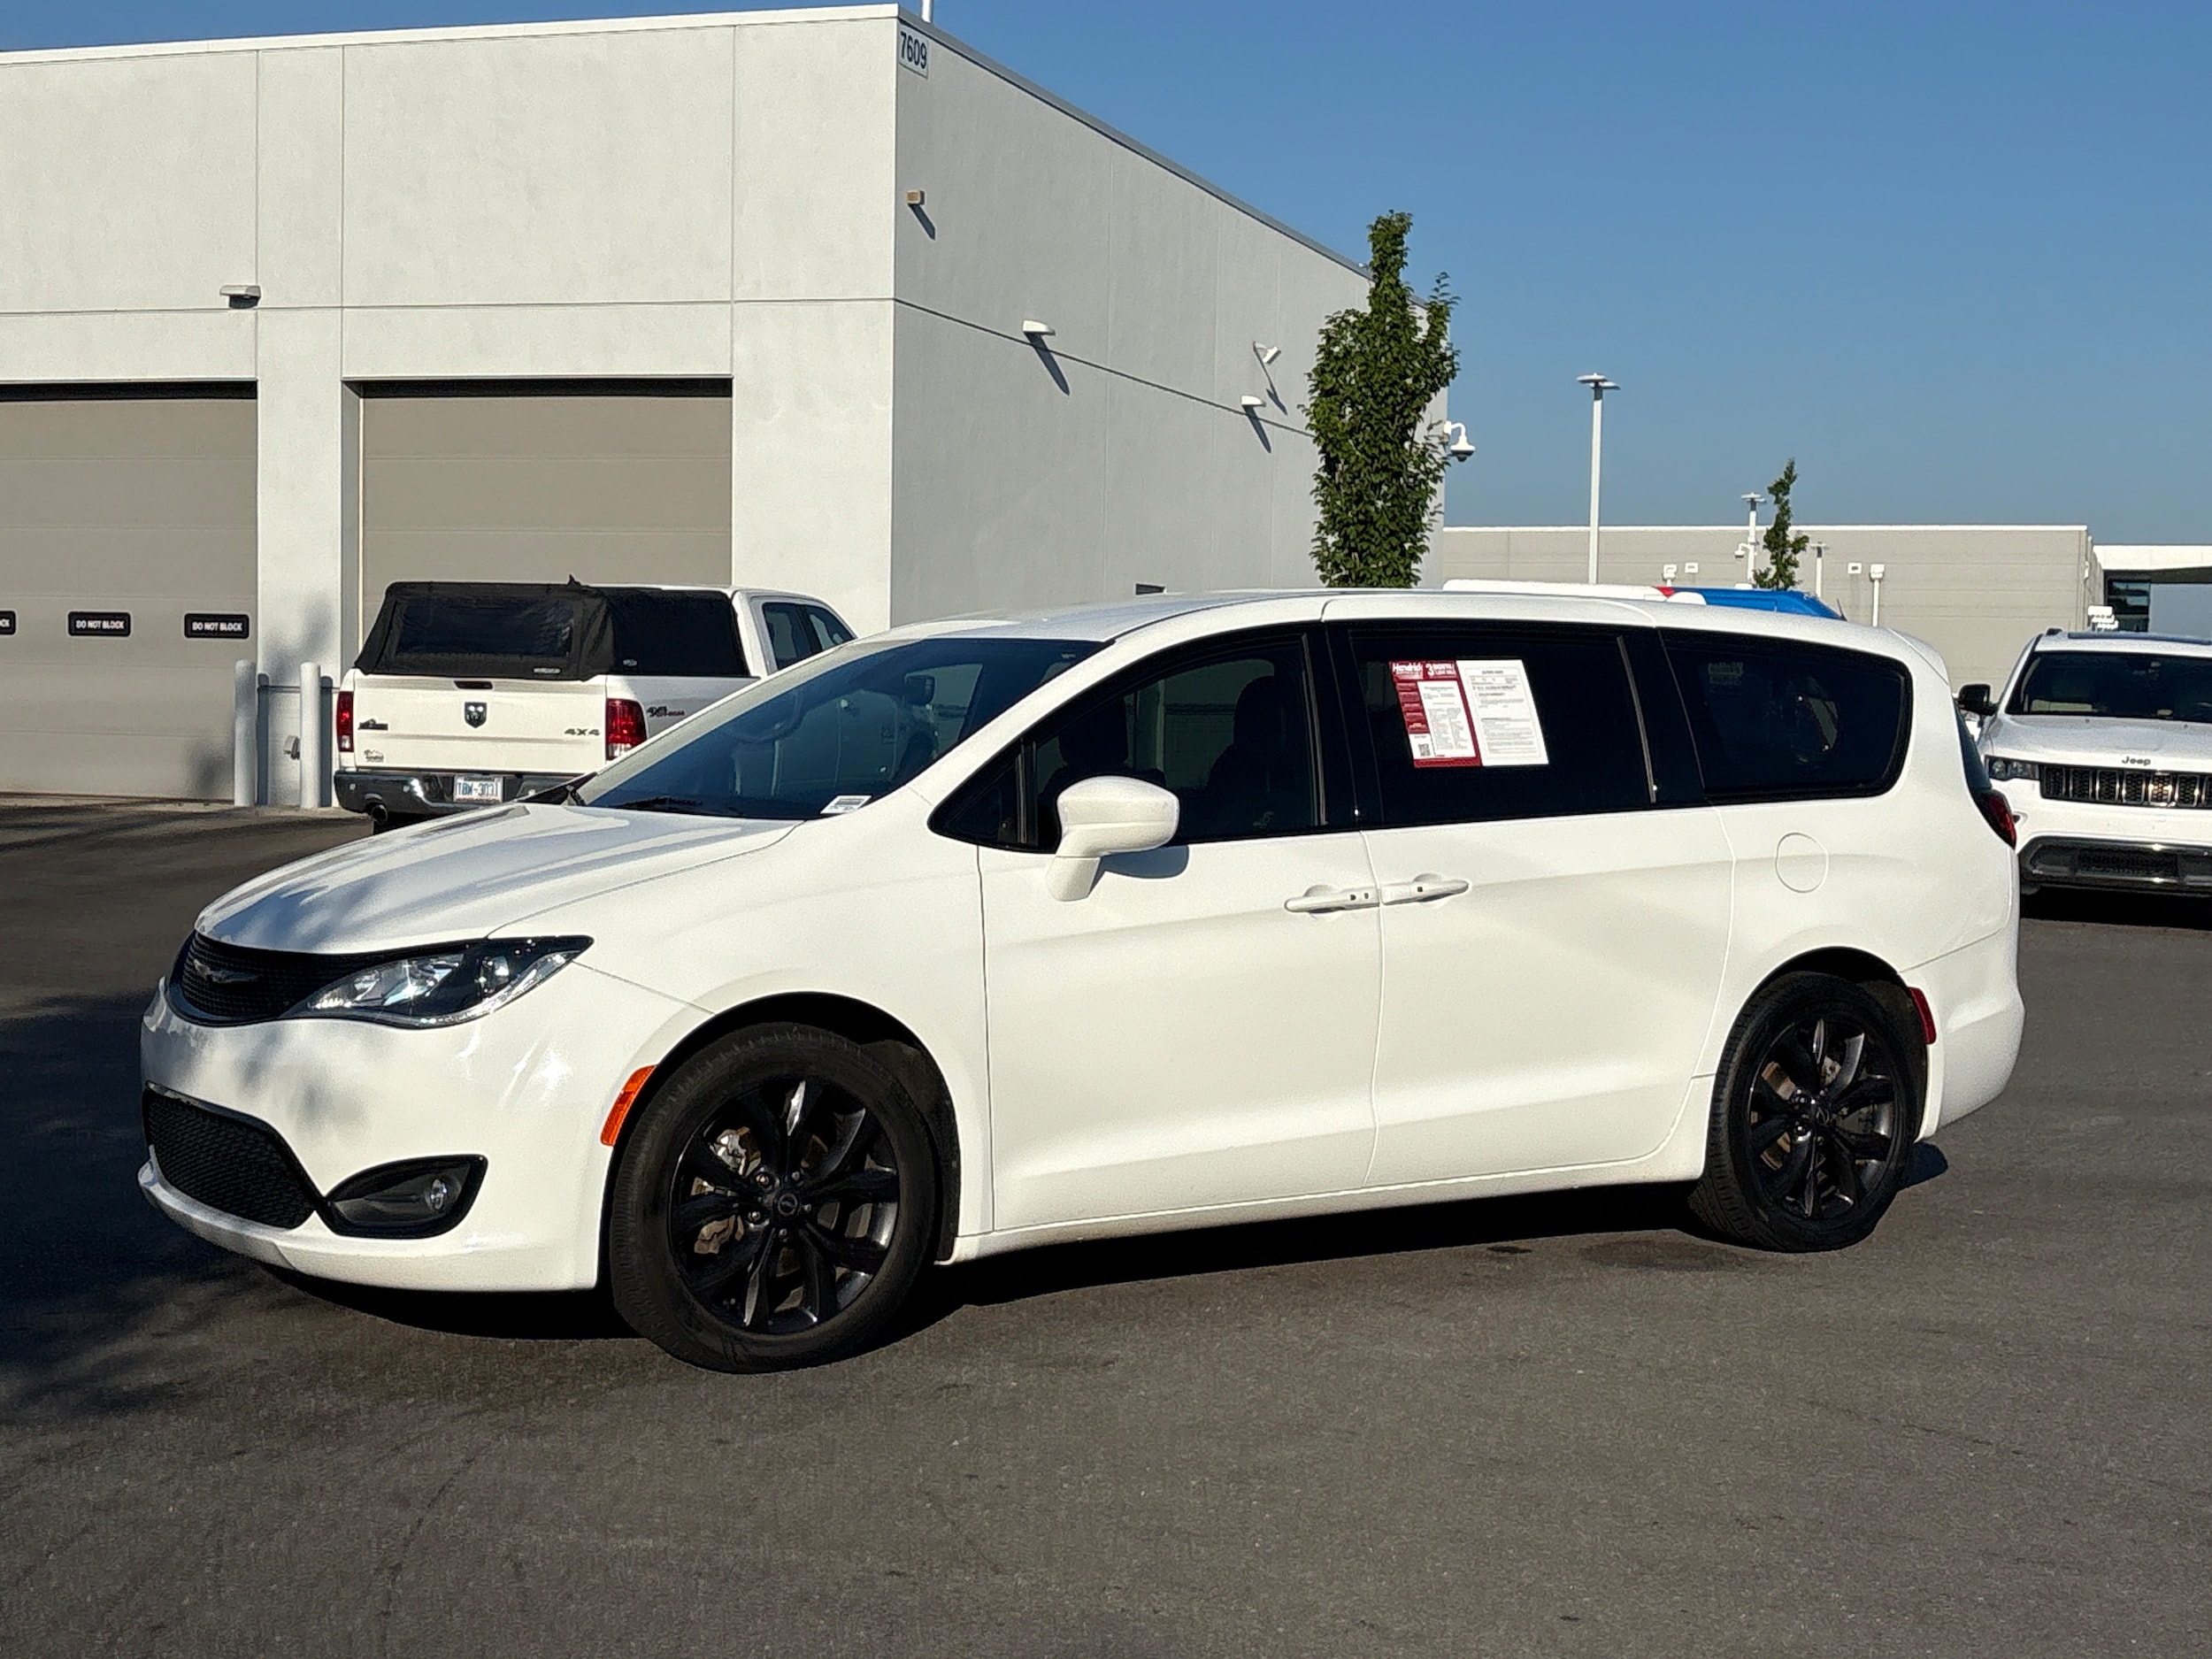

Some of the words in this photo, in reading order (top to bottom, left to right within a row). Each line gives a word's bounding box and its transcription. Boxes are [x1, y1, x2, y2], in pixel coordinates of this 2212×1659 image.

[900, 30, 927, 69] 7609
[76, 619, 87, 628] DO
[88, 619, 101, 629] NOT
[102, 620, 124, 629] BLOCK
[192, 621, 203, 631] DO
[204, 622, 219, 631] NOT
[219, 622, 242, 632] BLOCK
[1425, 663, 1434, 676] 3
[2121, 756, 2151, 766] Jeep
